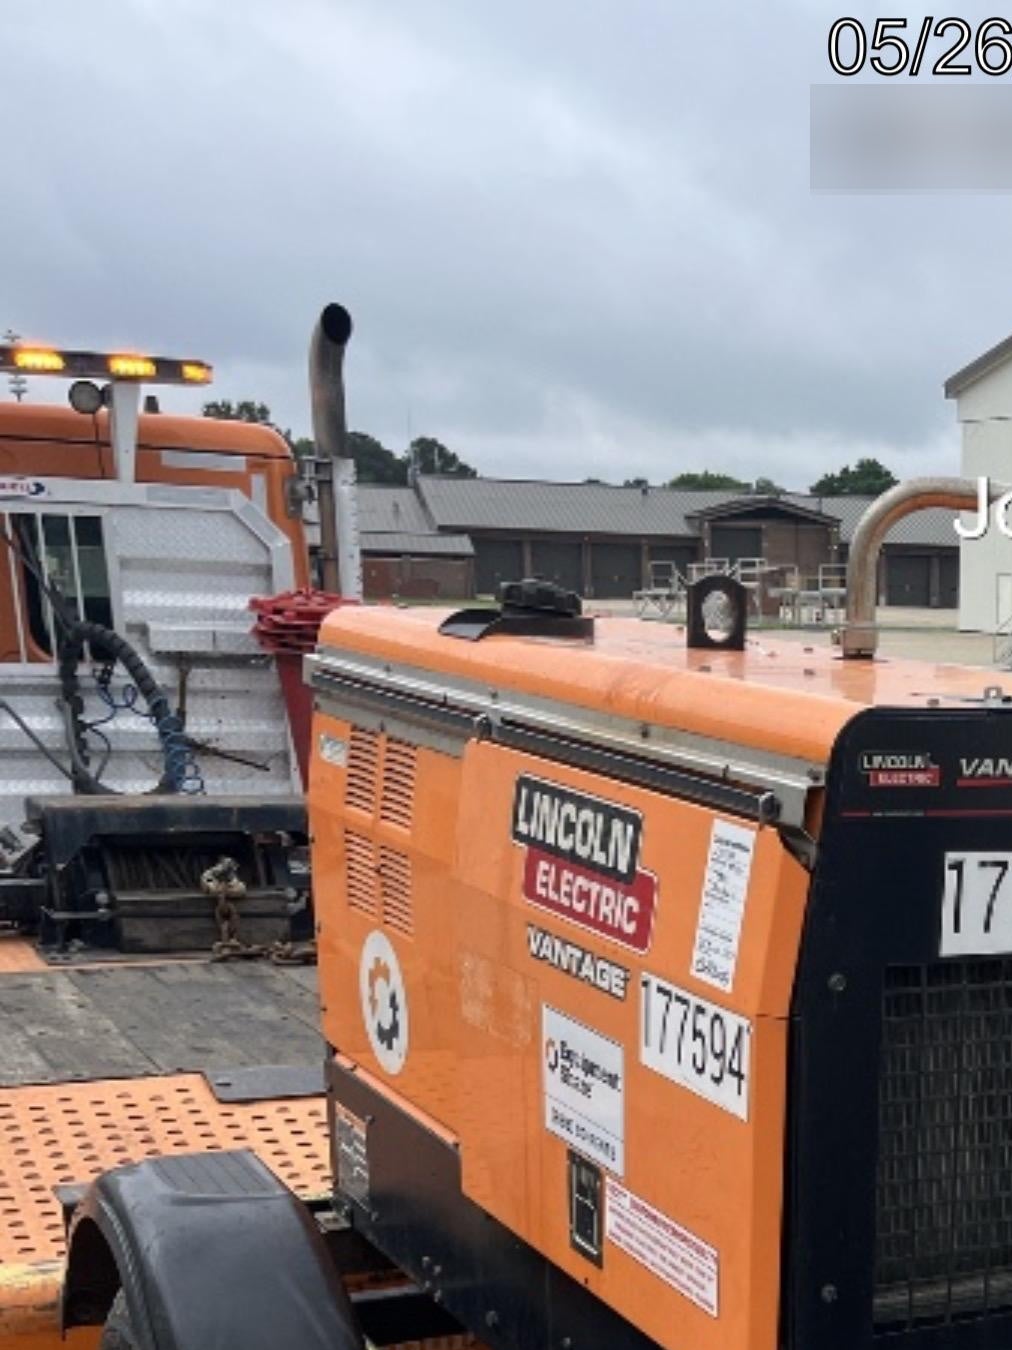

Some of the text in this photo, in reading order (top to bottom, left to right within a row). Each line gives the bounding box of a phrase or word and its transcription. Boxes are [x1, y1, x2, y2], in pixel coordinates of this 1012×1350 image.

[516, 786, 635, 874] LINCOLN
[535, 860, 640, 935] ELECTRIC
[527, 923, 629, 999] VANTAGE
[641, 979, 745, 1097] 177594
